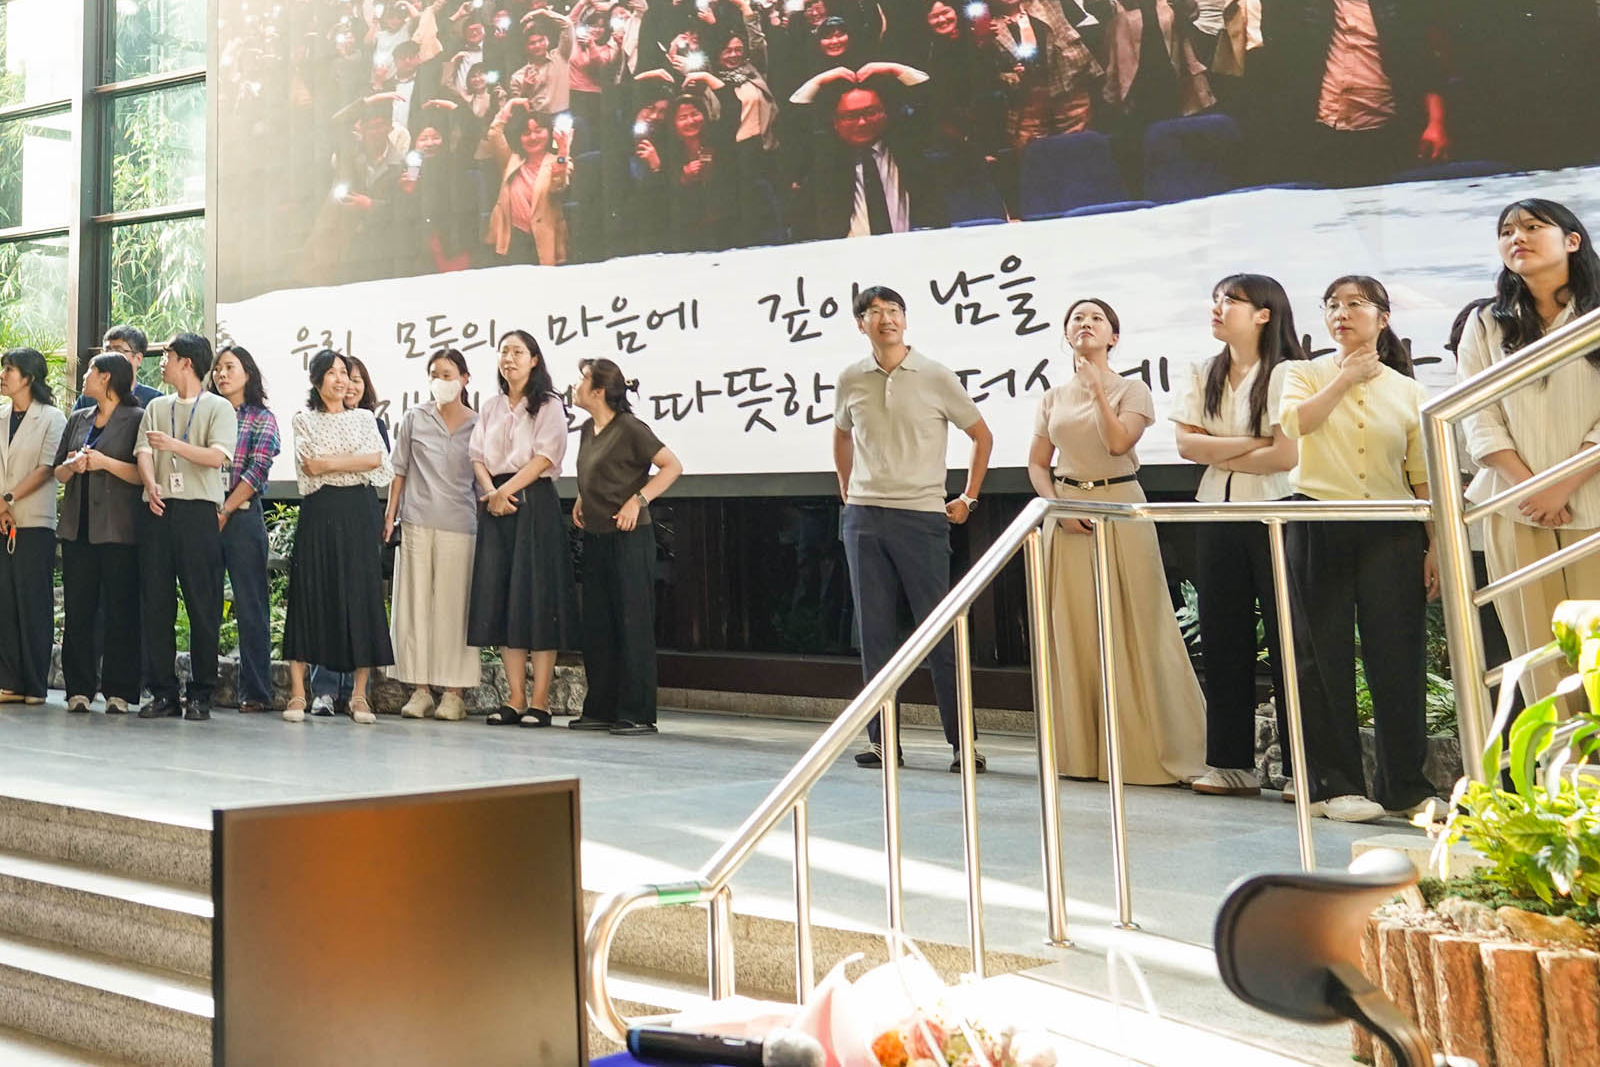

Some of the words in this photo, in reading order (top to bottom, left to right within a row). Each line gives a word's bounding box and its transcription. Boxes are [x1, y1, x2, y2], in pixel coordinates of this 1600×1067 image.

[291, 325, 352, 371] 우리
[396, 315, 496, 359] 모두의
[549, 295, 699, 355] 마음에
[757, 275, 859, 343] 깊이
[929, 254, 1051, 336] 남을
[649, 366, 836, 433] 따뜻한
